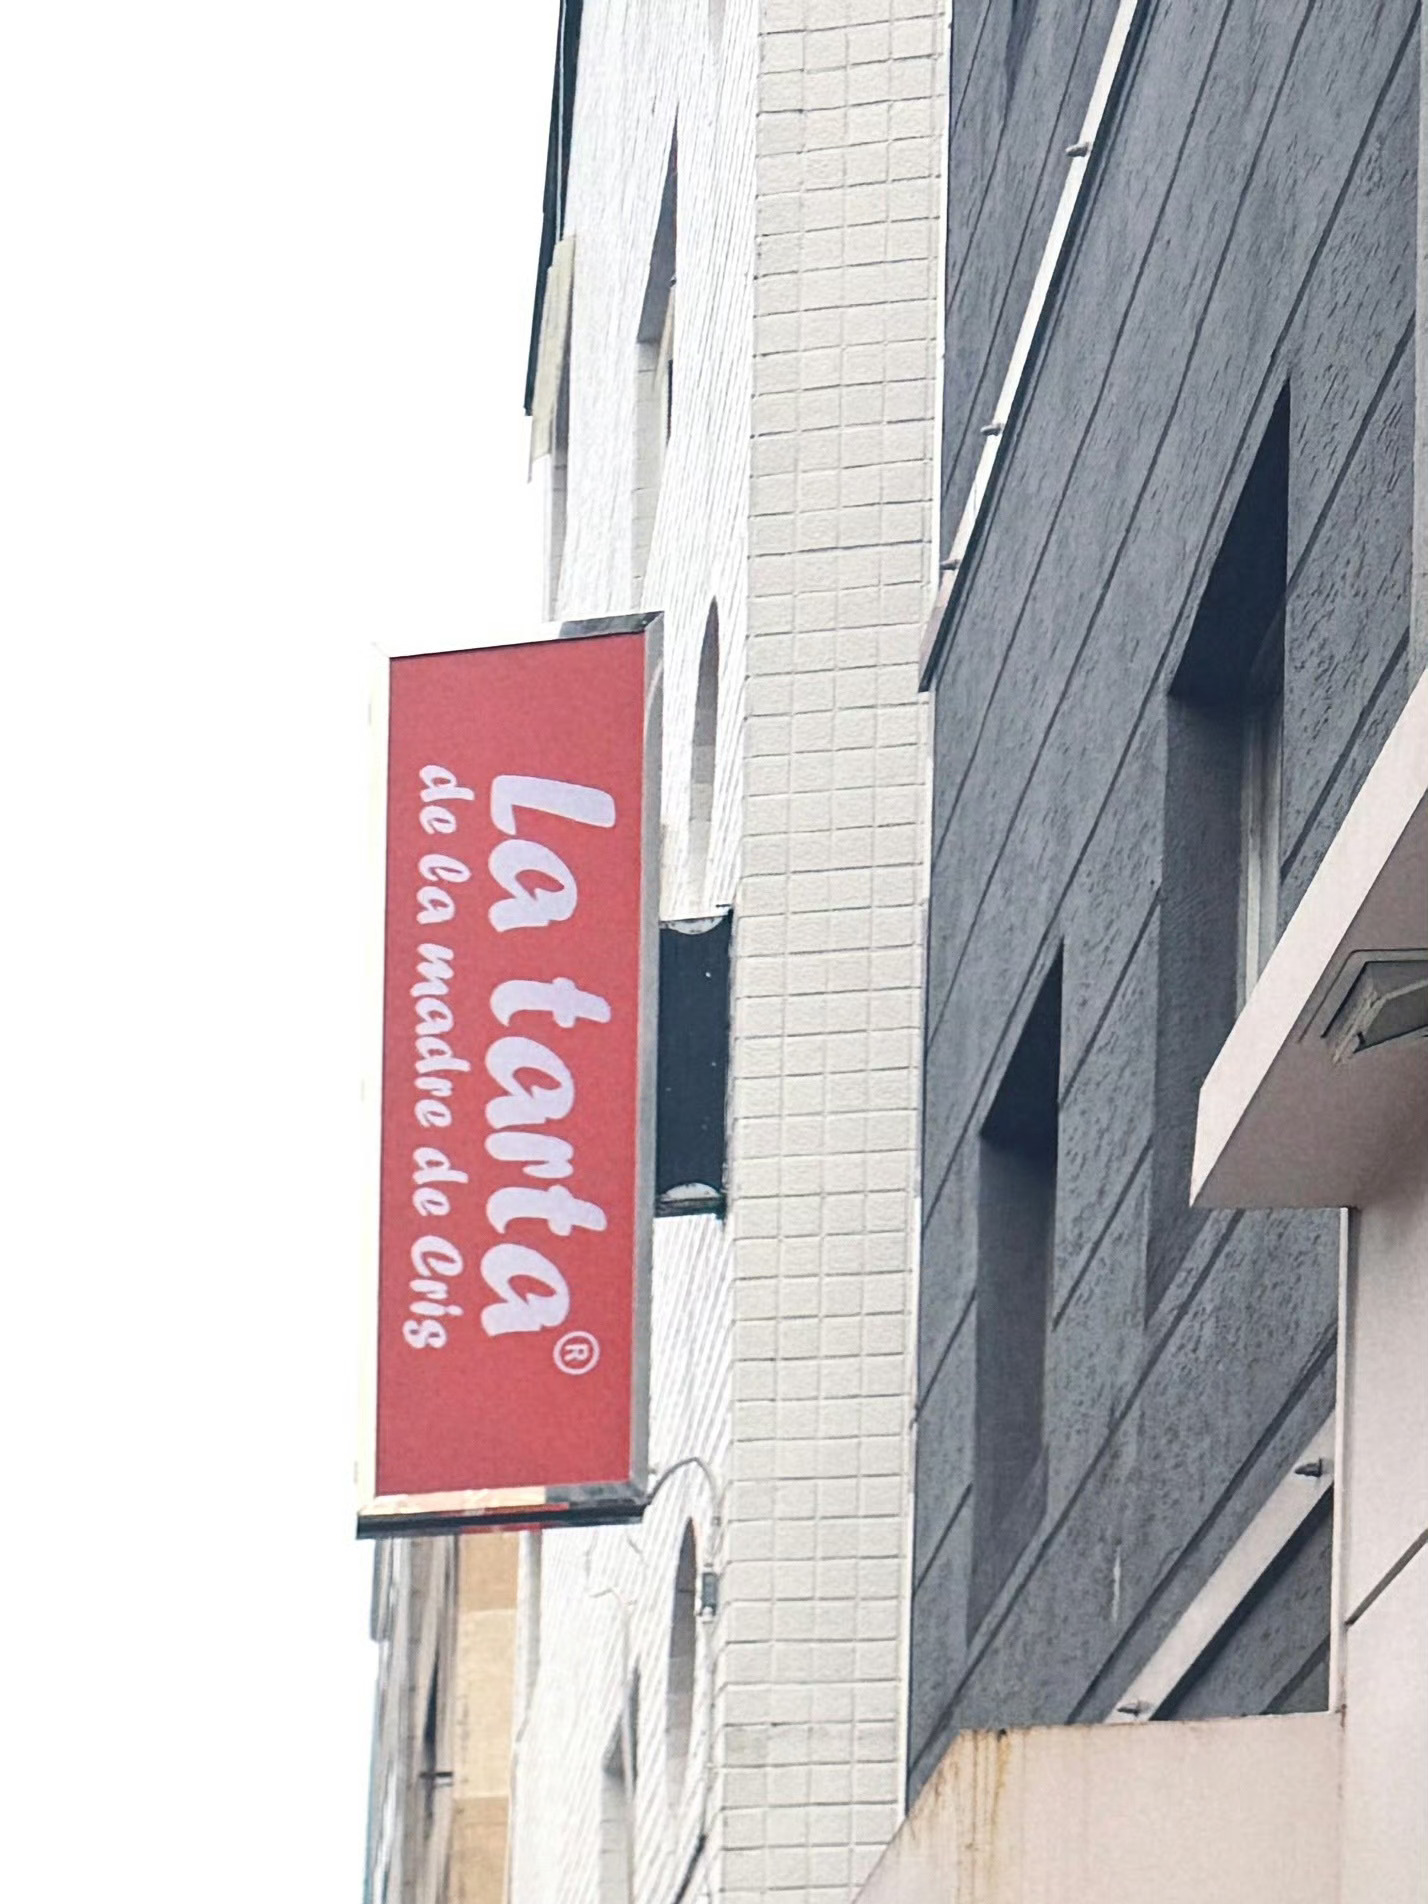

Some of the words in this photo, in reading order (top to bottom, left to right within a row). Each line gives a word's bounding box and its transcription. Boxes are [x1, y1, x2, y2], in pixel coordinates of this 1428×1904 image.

[419, 765, 474, 834] de
[488, 775, 616, 932] La
[417, 854, 471, 927] la
[410, 943, 470, 1129] madre
[411, 1146, 468, 1217] de
[481, 976, 611, 1338] tarta
[403, 1234, 463, 1349] Cris
